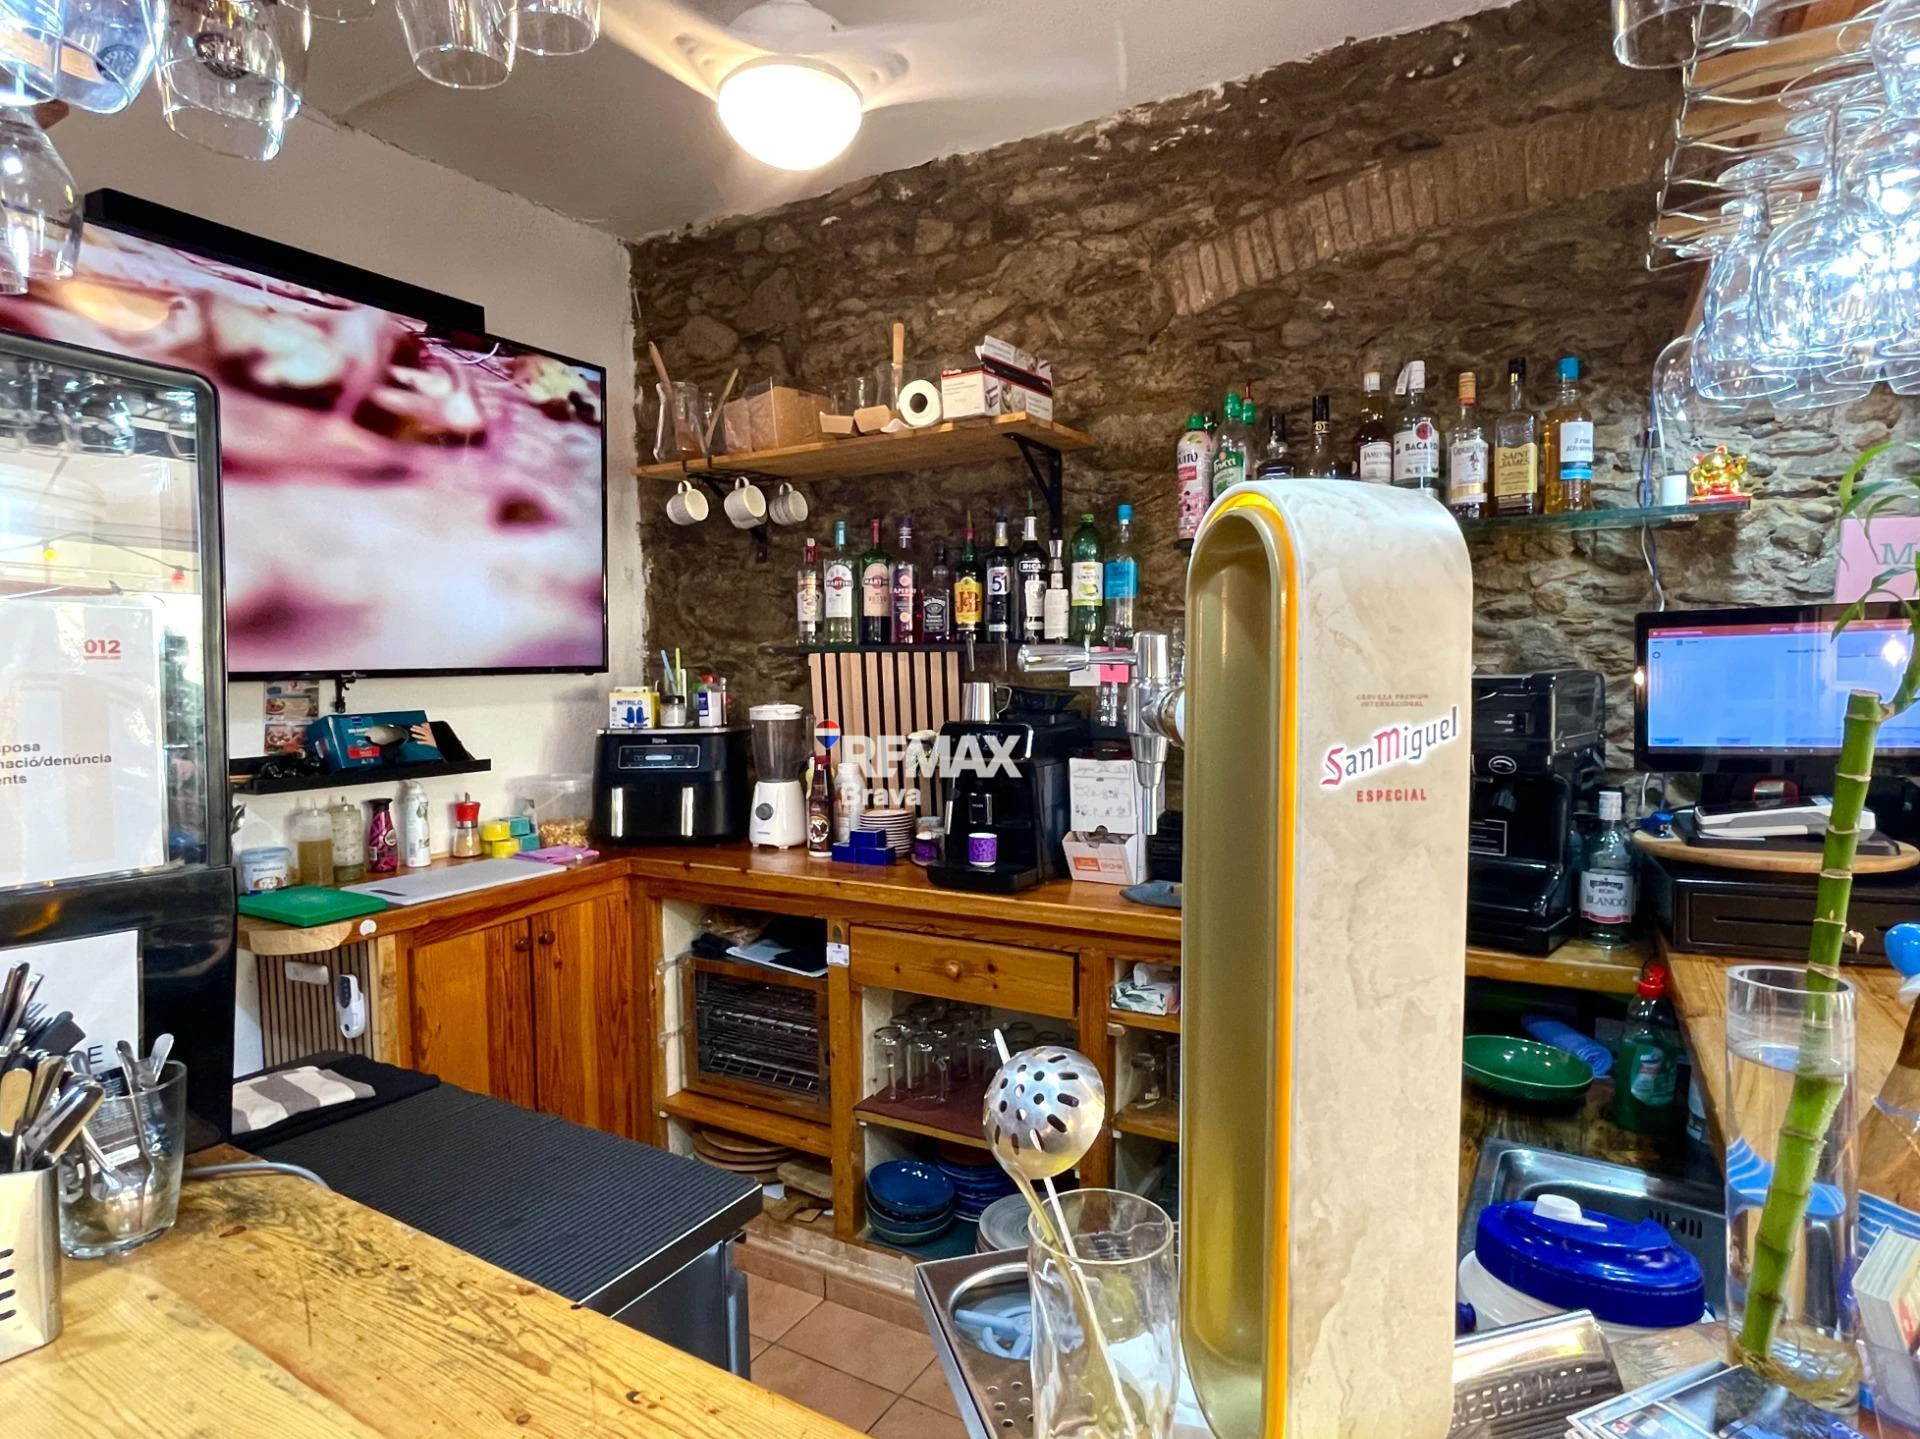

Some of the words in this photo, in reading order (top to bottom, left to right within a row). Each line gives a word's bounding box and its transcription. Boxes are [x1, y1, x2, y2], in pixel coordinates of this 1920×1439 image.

[1405, 441, 1438, 451] BACAD
[992, 575, 1008, 593] 51
[893, 587, 917, 595] APERL
[84, 639, 121, 654] 012
[0, 743, 41, 755] posa
[0, 774, 28, 785] nts
[1356, 788, 1428, 803] ESPECIAL
